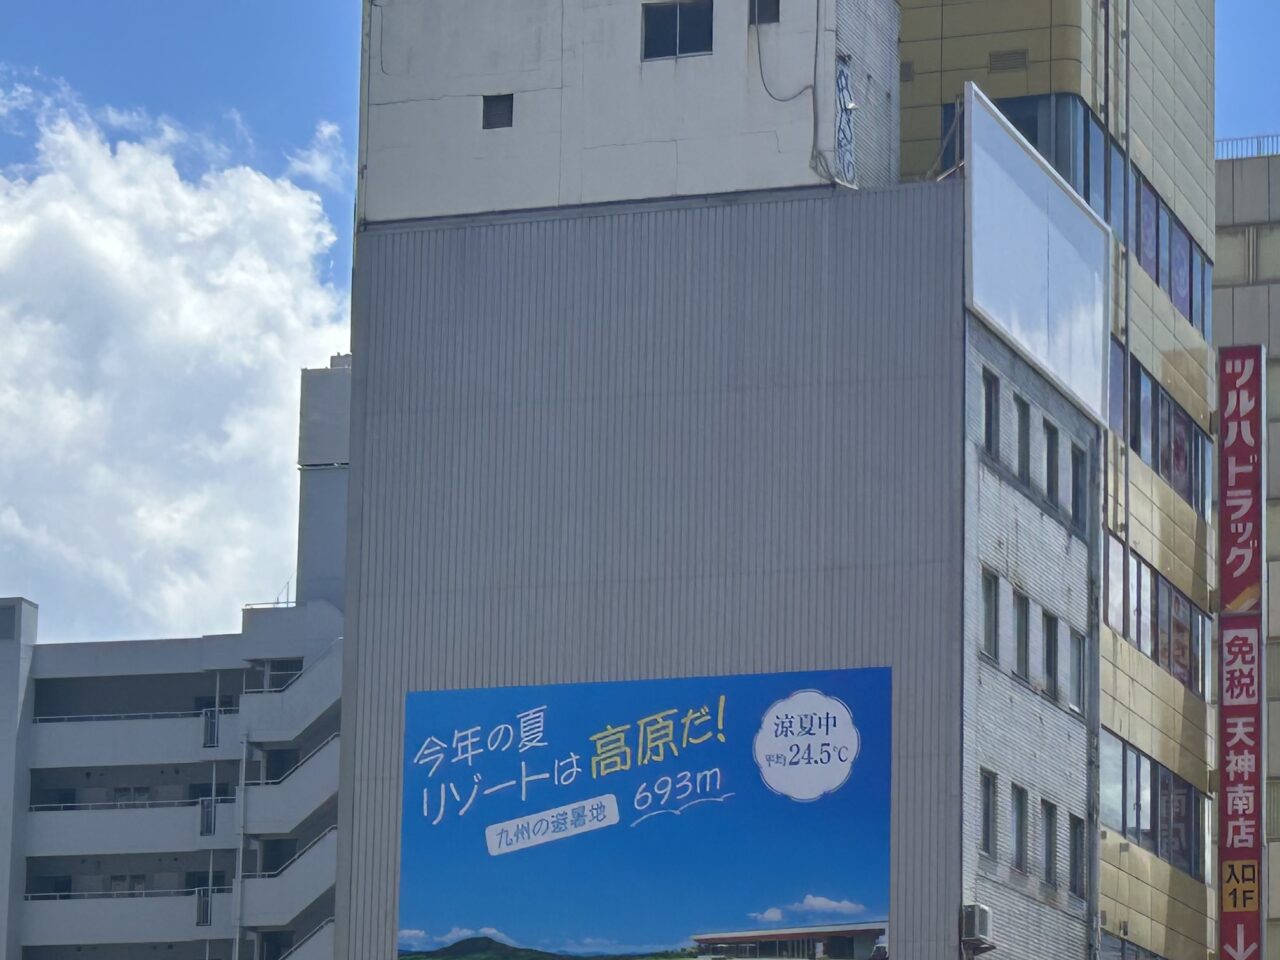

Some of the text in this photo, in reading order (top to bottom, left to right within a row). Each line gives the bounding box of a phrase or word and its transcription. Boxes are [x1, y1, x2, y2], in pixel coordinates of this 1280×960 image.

[1224, 359, 1257, 578] ツルハドラッグ
[1225, 635, 1256, 700] 免税
[413, 705, 549, 778] 今年の夏
[773, 712, 838, 738] 涼夏中
[423, 696, 727, 825] リゾートは 高原だ!
[764, 752, 786, 767] 平均
[1226, 717, 1256, 849] 天神南店
[634, 768, 721, 811] 693m
[1226, 864, 1256, 884] 入口
[1228, 888, 1254, 908] 1F
